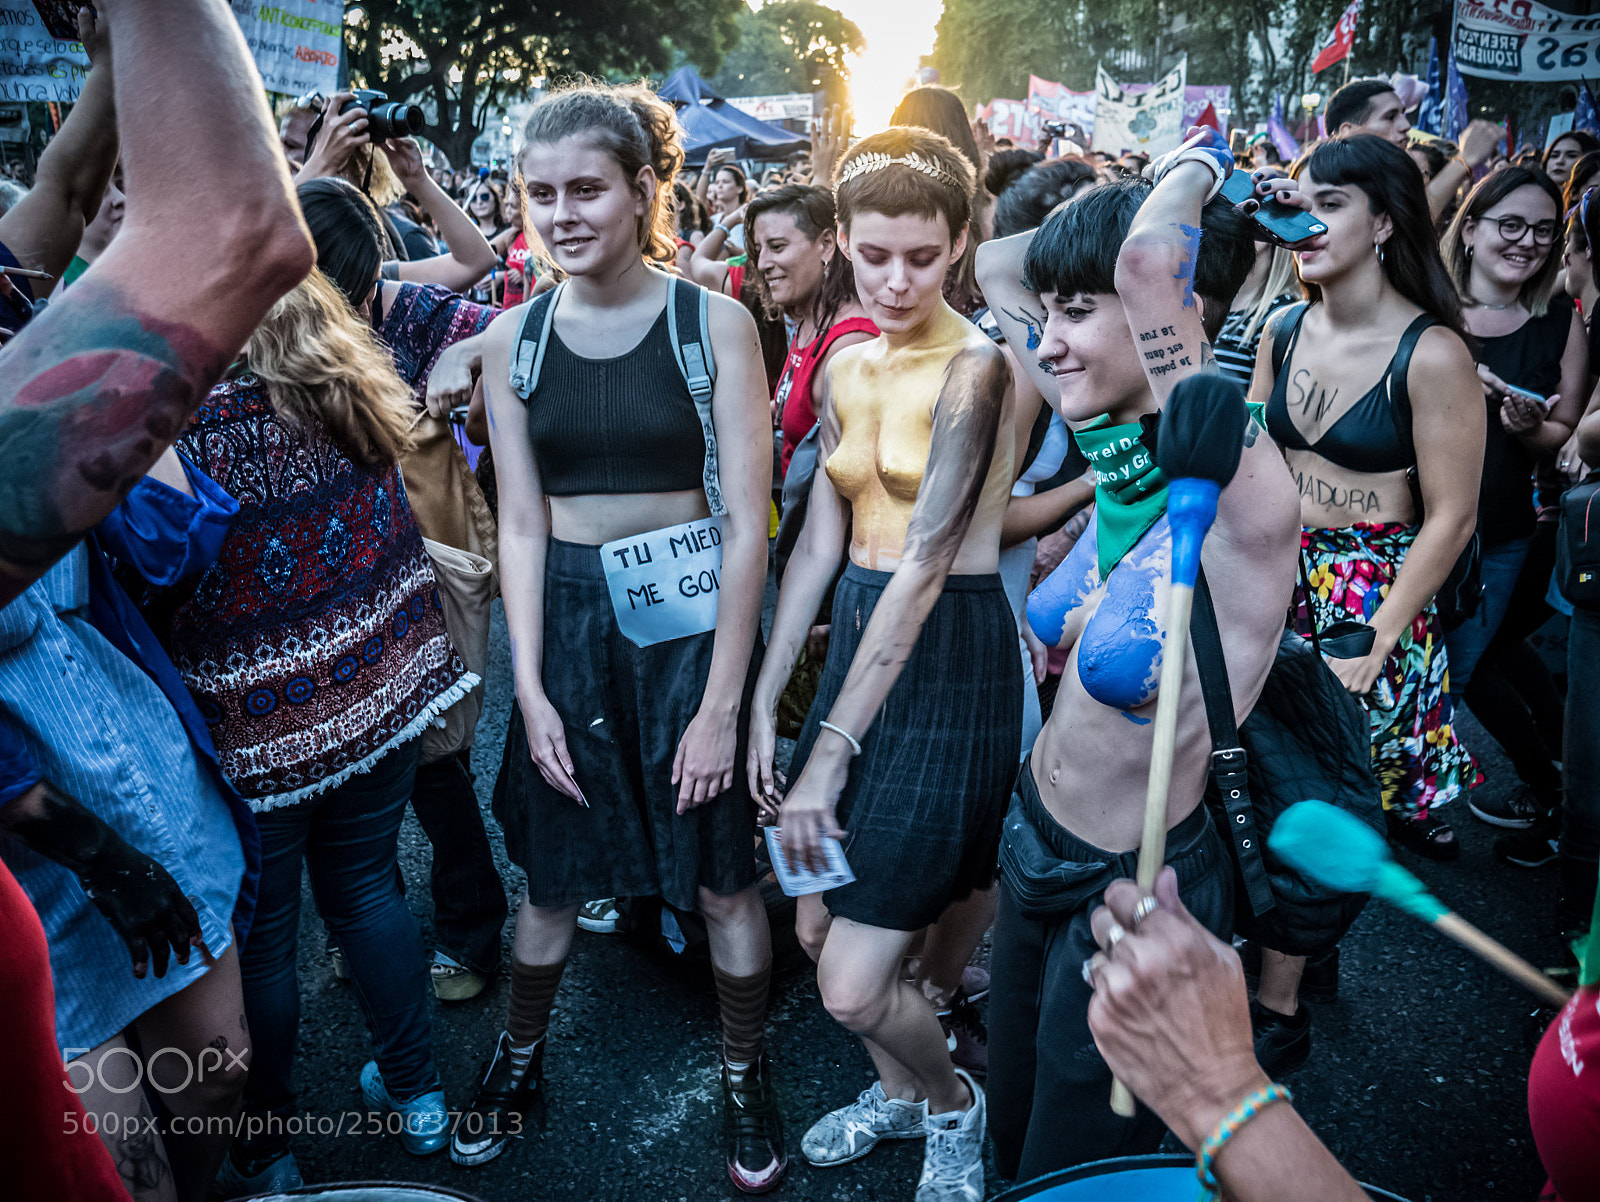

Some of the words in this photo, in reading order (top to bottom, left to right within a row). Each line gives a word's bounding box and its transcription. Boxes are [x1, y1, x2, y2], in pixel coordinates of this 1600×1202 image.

[1139, 329, 1159, 342] rue
[1161, 325, 1176, 336] la
[1167, 342, 1184, 355] est
[1288, 369, 1339, 423] SIN
[1101, 442, 1117, 458] el
[1119, 464, 1130, 480] y
[612, 542, 653, 569] TU
[627, 583, 664, 610] ME
